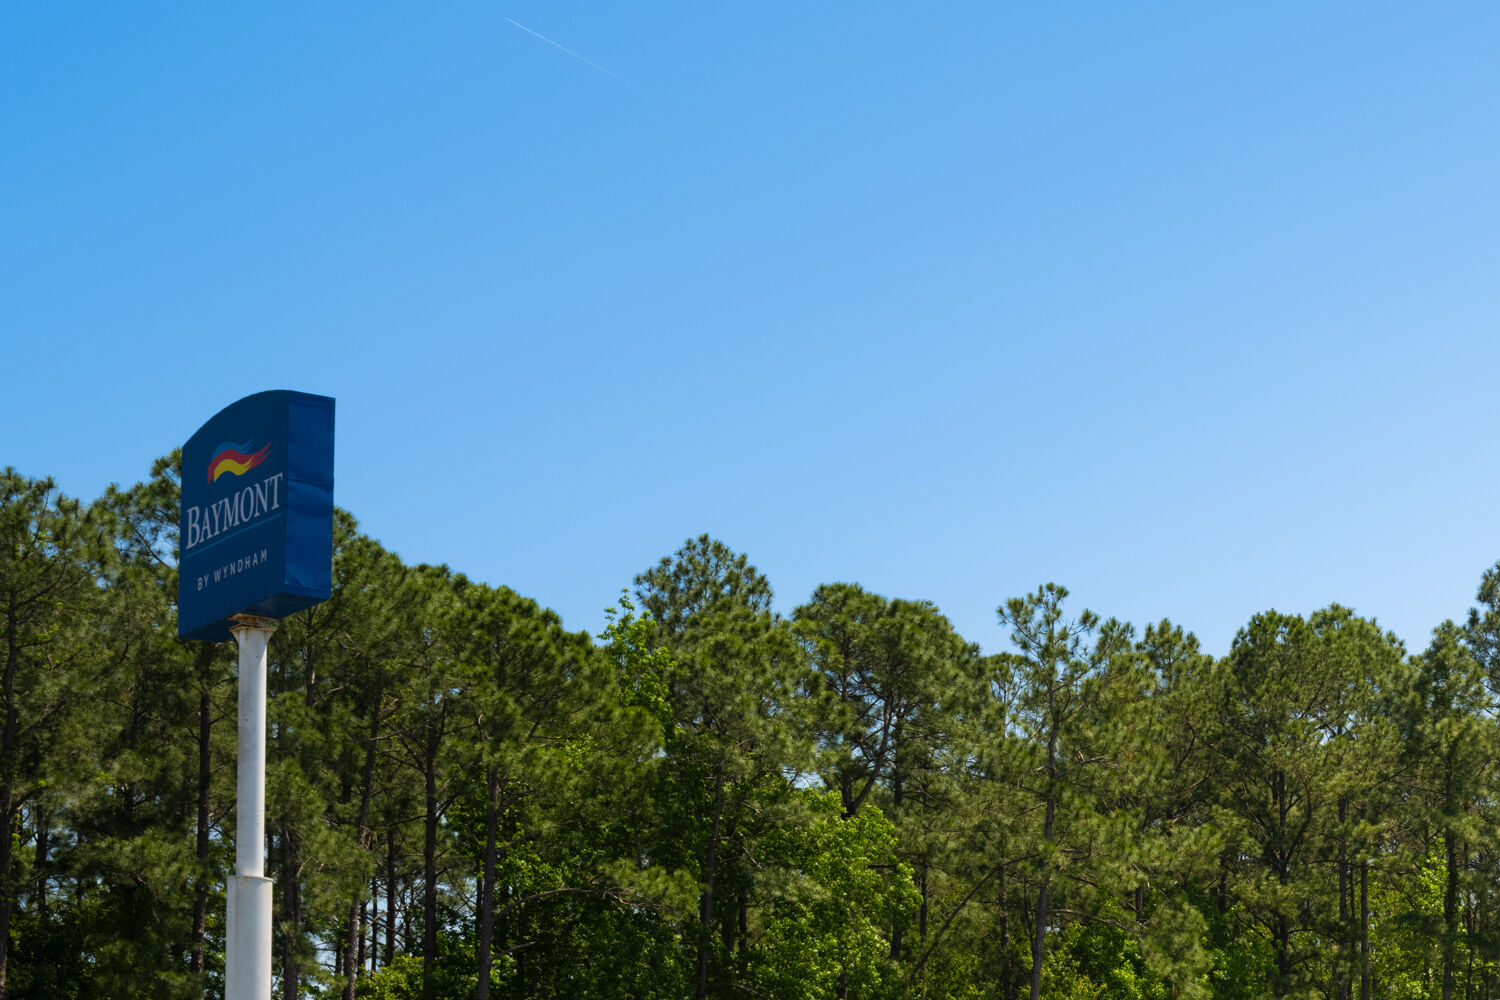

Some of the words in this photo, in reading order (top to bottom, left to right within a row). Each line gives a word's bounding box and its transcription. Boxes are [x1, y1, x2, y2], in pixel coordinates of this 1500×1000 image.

[185, 472, 283, 549] BAYMONT
[197, 574, 209, 591] BY
[213, 549, 268, 582] WYNDHAM
